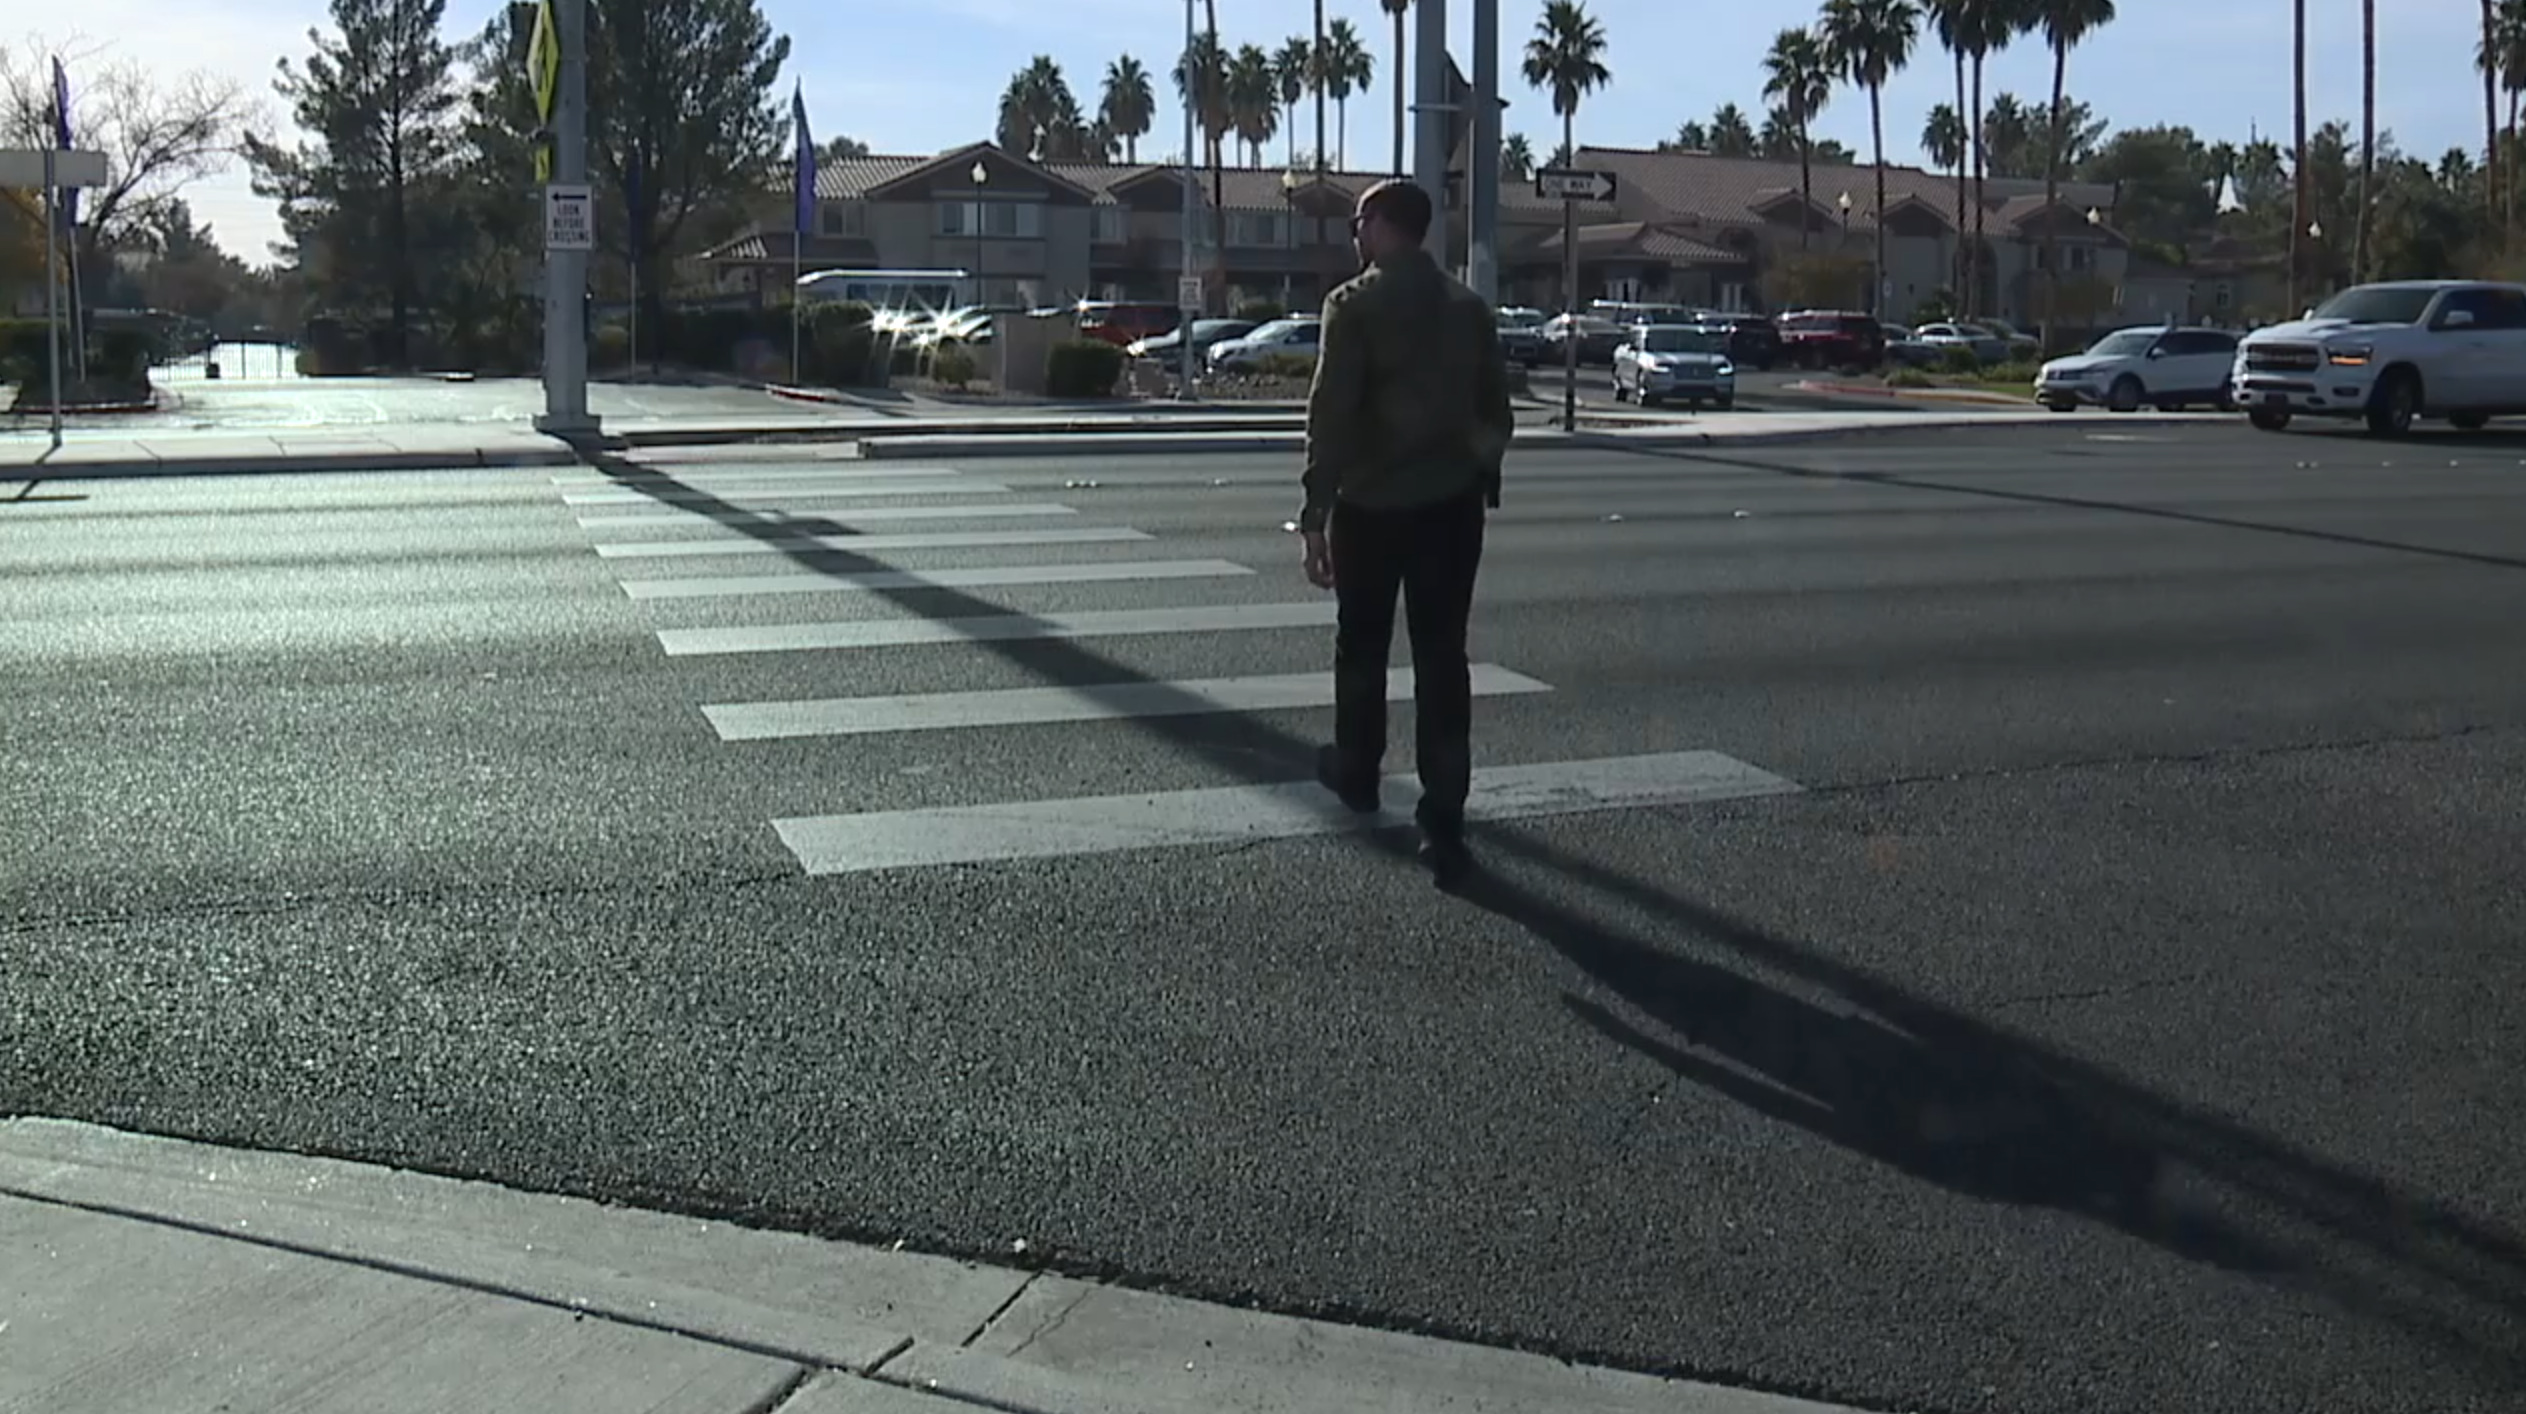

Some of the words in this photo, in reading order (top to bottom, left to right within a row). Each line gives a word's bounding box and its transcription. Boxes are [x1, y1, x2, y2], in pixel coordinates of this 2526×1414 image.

[557, 203, 580, 215] LOOK
[553, 216, 584, 228] BEFORE
[548, 230, 591, 244] CROSSING
